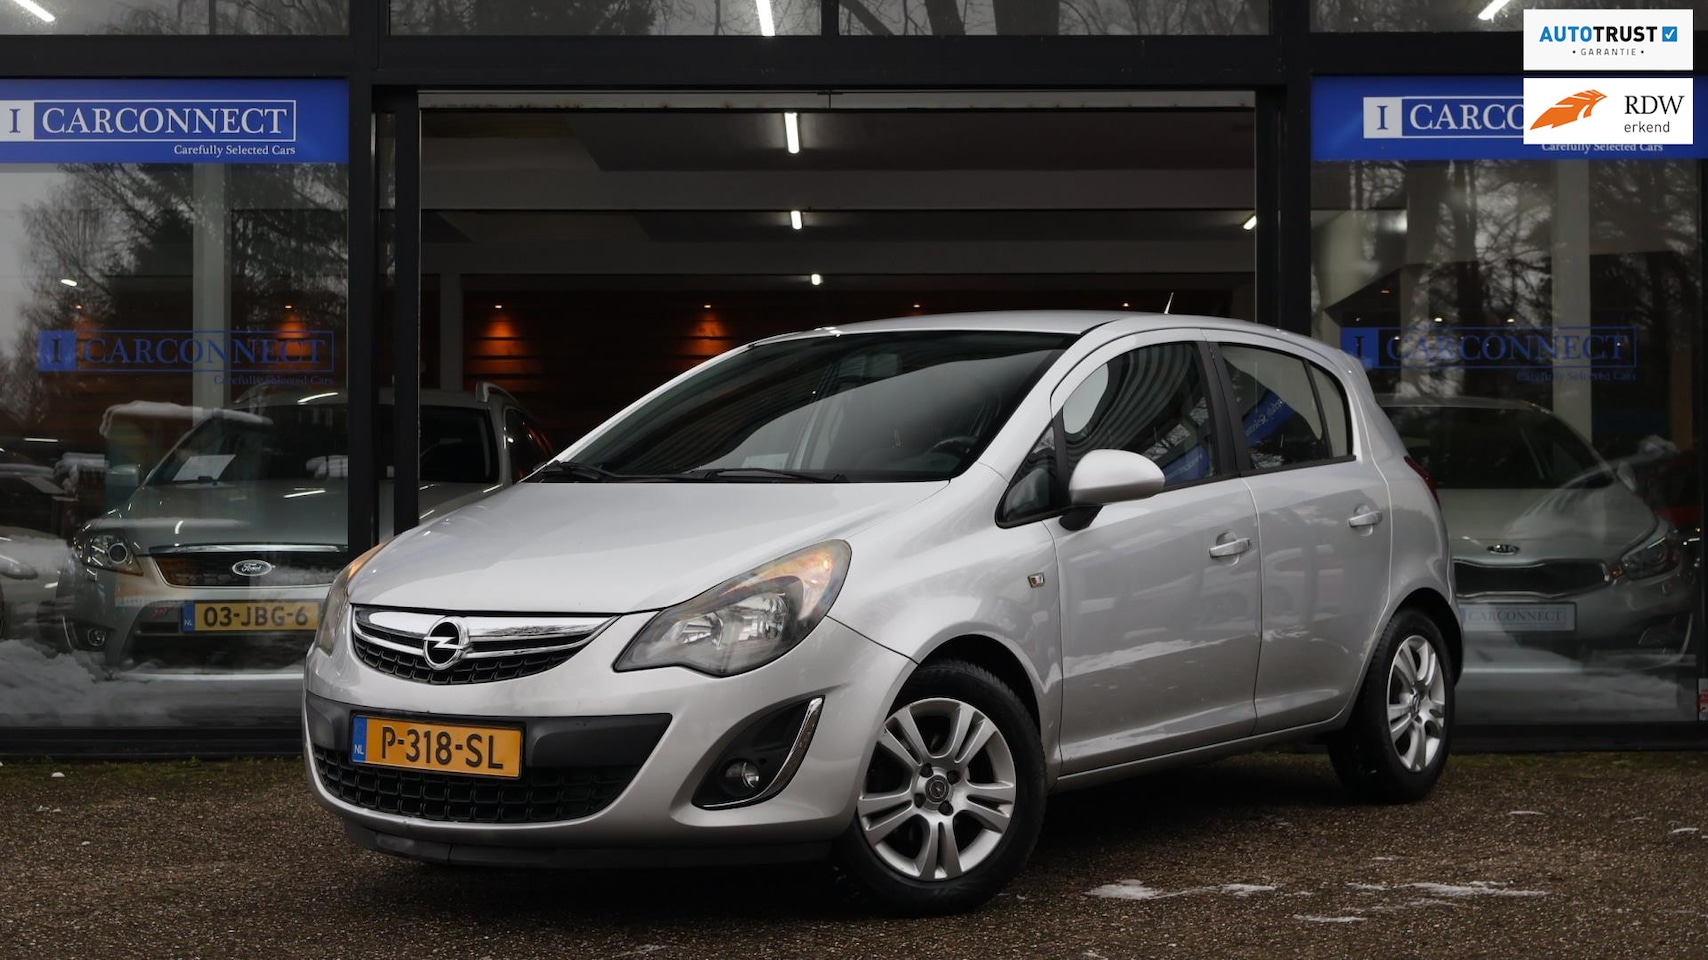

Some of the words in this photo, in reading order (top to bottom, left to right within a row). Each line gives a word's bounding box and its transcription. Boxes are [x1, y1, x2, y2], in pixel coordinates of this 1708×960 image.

[42, 107, 288, 134] CARCONNECT
[174, 144, 223, 158] Carefully
[226, 144, 269, 155] Selected
[271, 145, 296, 155] Cars
[83, 337, 326, 364] CARCONNECT
[1386, 334, 1628, 361] CARCONNECT
[203, 606, 309, 627] 03-JBG-6
[1468, 610, 1562, 622] CARCONNECT
[354, 744, 364, 755] NL
[381, 726, 504, 770] P-318-SL
